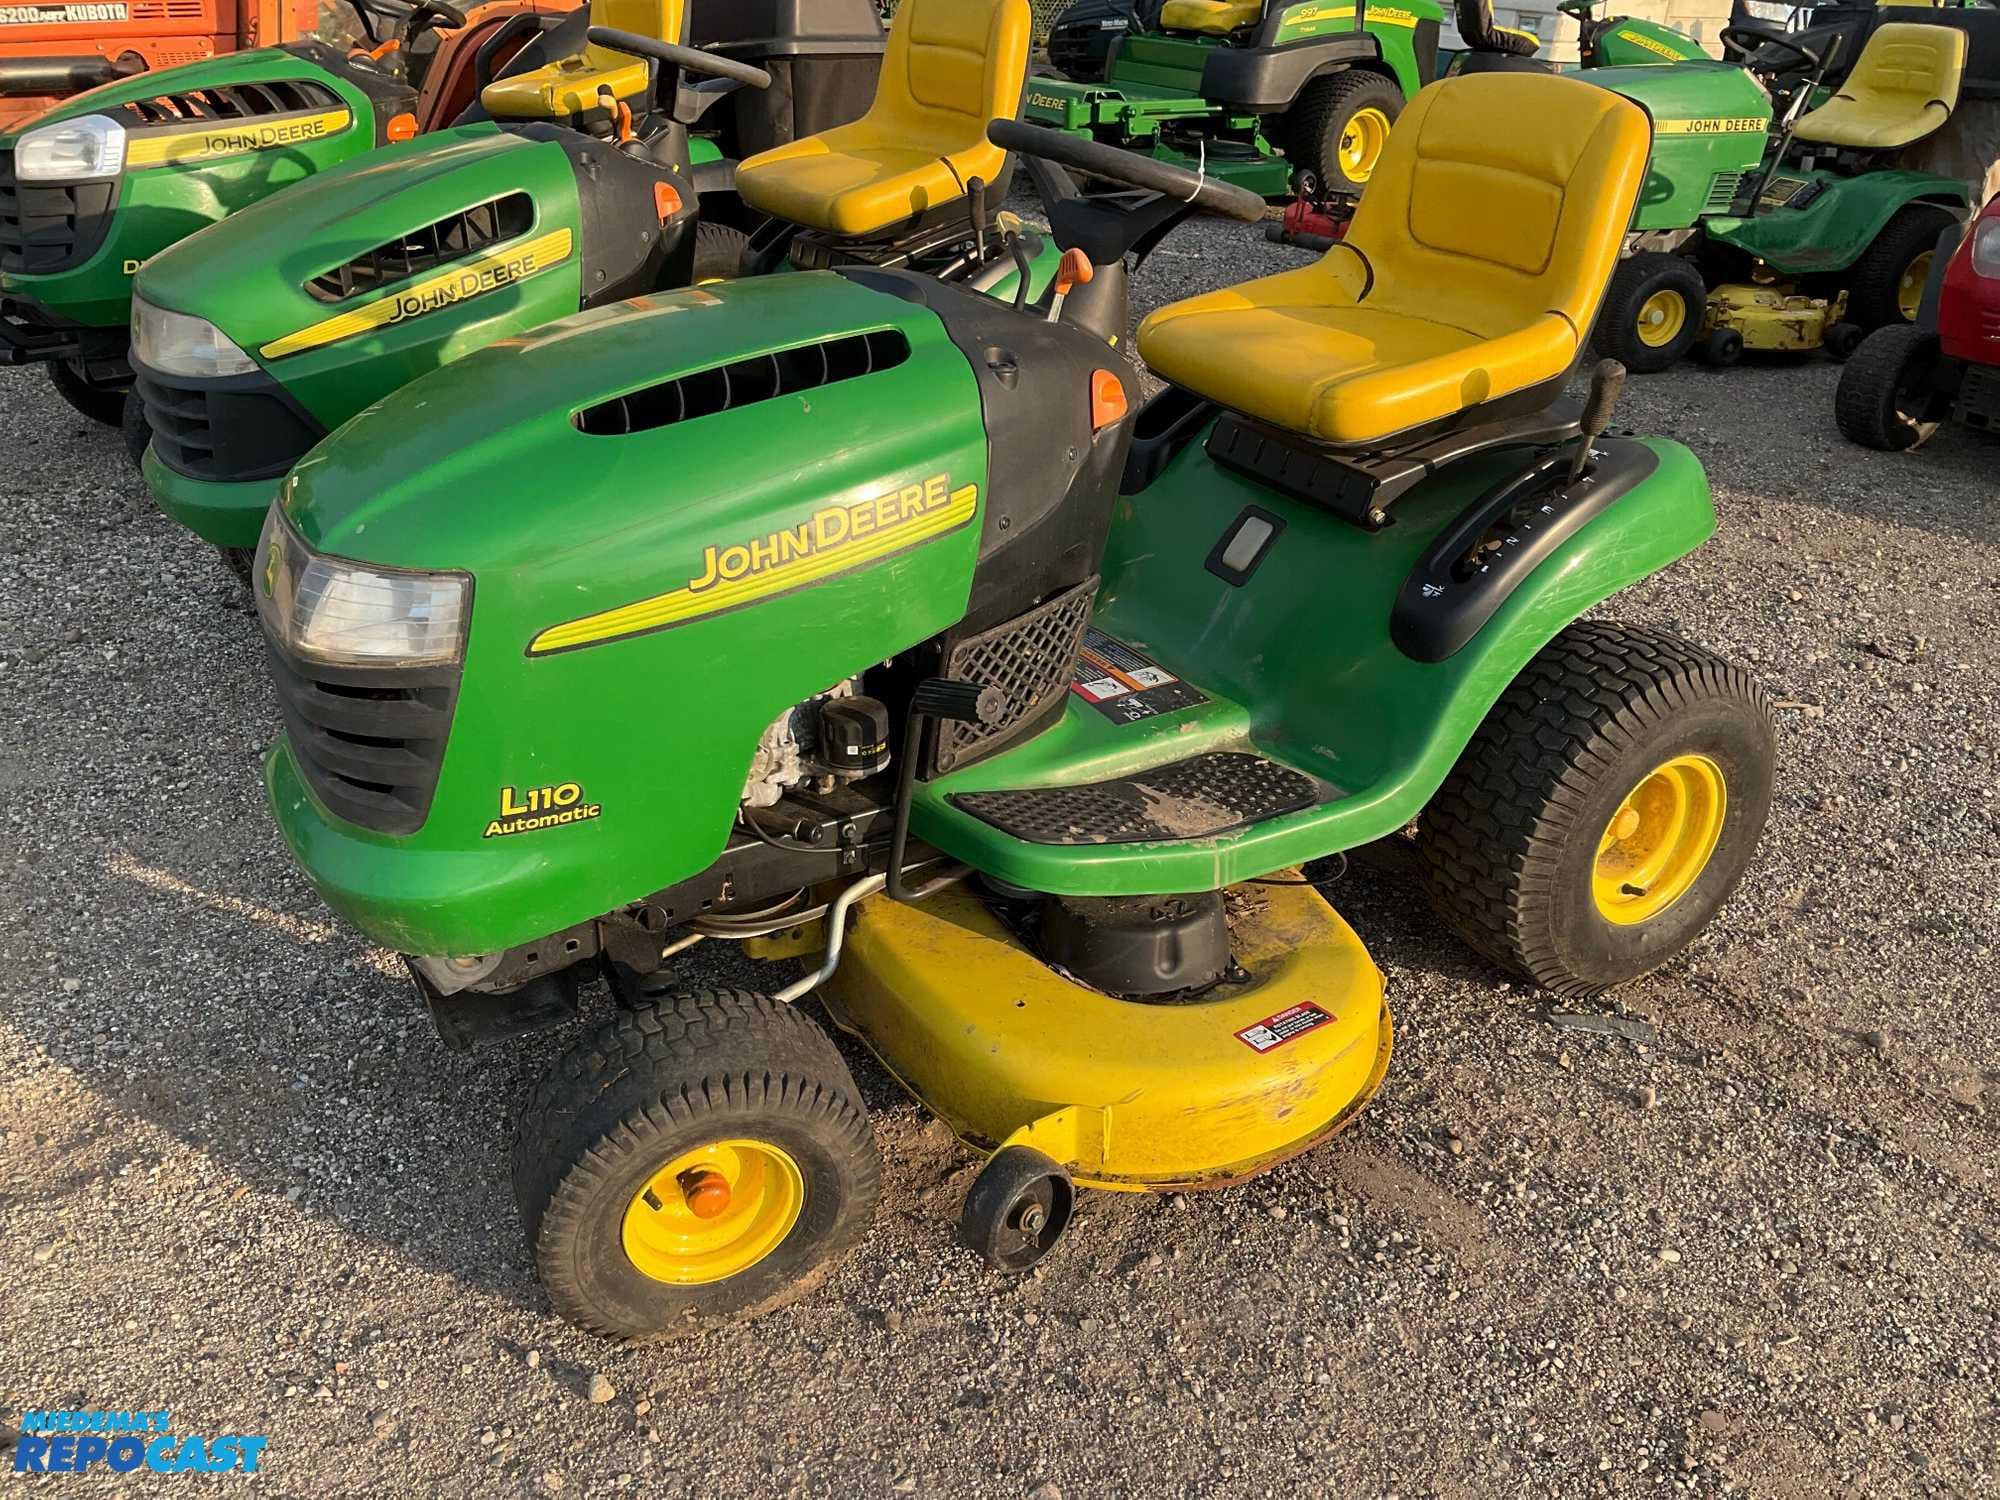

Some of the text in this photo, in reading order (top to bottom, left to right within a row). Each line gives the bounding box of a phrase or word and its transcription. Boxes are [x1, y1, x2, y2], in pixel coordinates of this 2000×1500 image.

[65, 4, 125, 21] KUBOTA
[1301, 7, 1318, 18] 997
[1368, 5, 1388, 17] JOHN
[1032, 93, 1067, 110] DEERE
[202, 120, 325, 154] JOHN DEERE
[1686, 119, 1762, 132] JOHN DEERE
[390, 254, 537, 321] JOHN DEERE
[689, 472, 950, 591] JOHN DEERE
[501, 782, 582, 816] L110
[485, 804, 600, 836] Automatic
